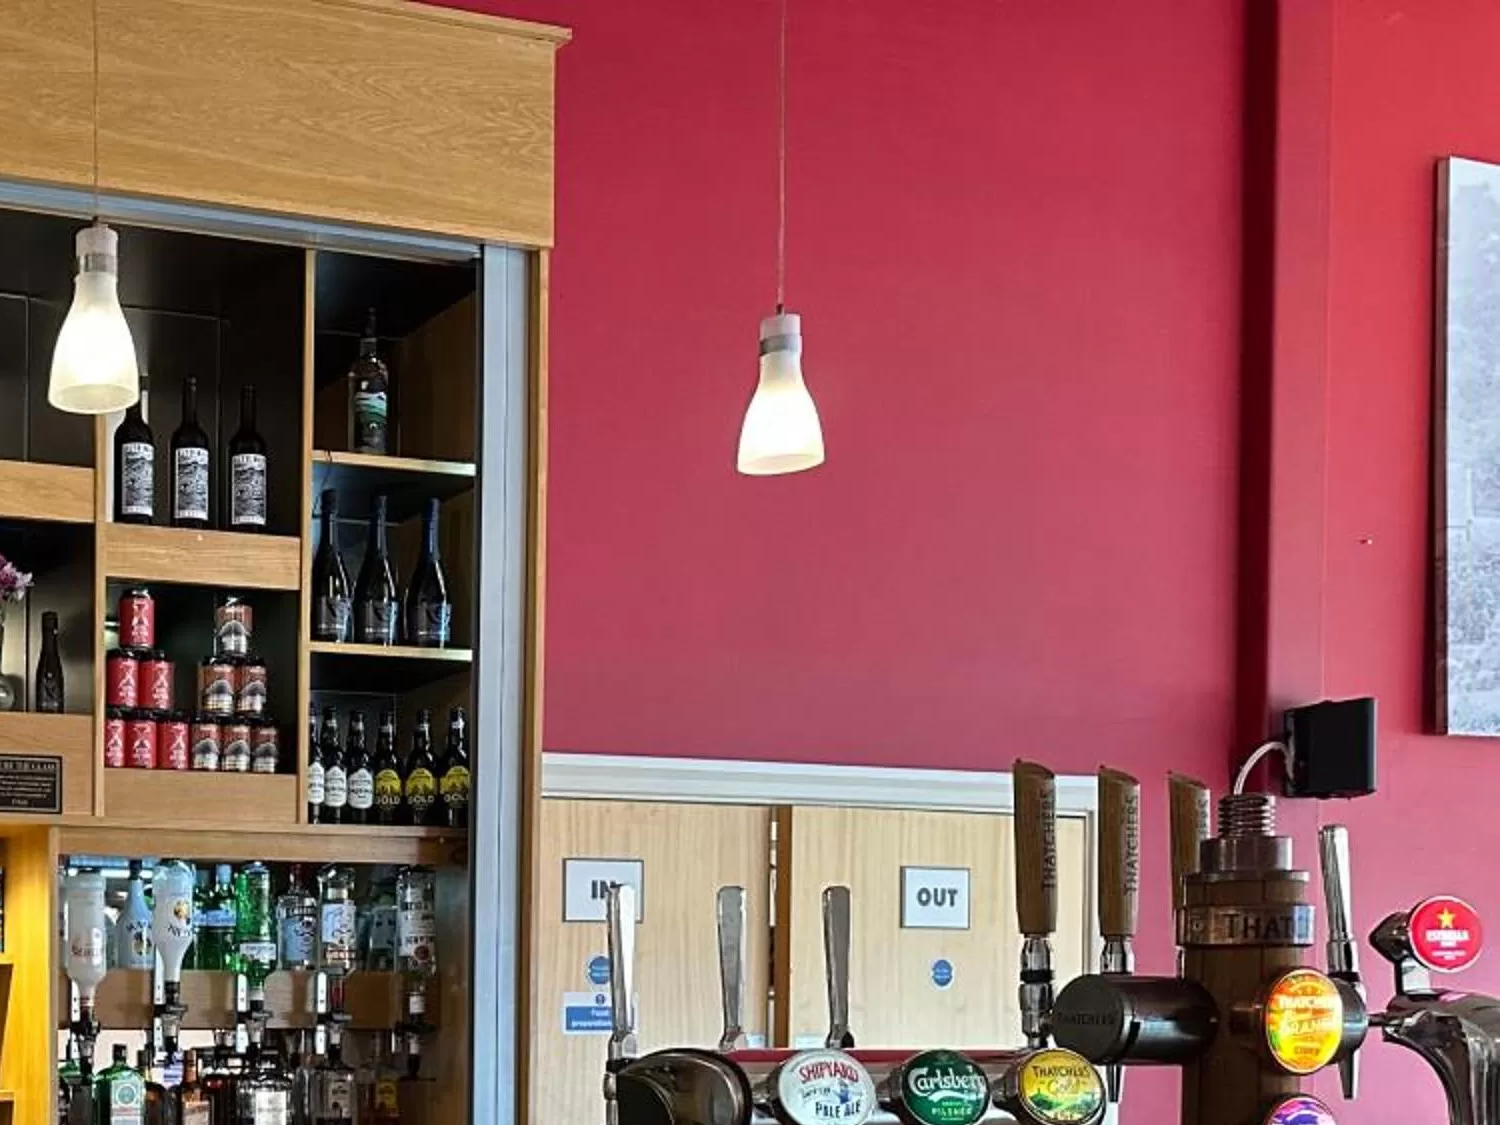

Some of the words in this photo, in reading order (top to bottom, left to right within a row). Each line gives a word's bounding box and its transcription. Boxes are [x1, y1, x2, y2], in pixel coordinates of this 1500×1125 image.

[916, 887, 959, 908] OUT
[799, 1061, 859, 1084] SHIPYARD
[908, 1064, 987, 1097] Carlsberg
[1032, 1064, 1091, 1079] THATCHERS
[815, 1100, 841, 1119] PALE
[843, 1099, 861, 1117] ALE
